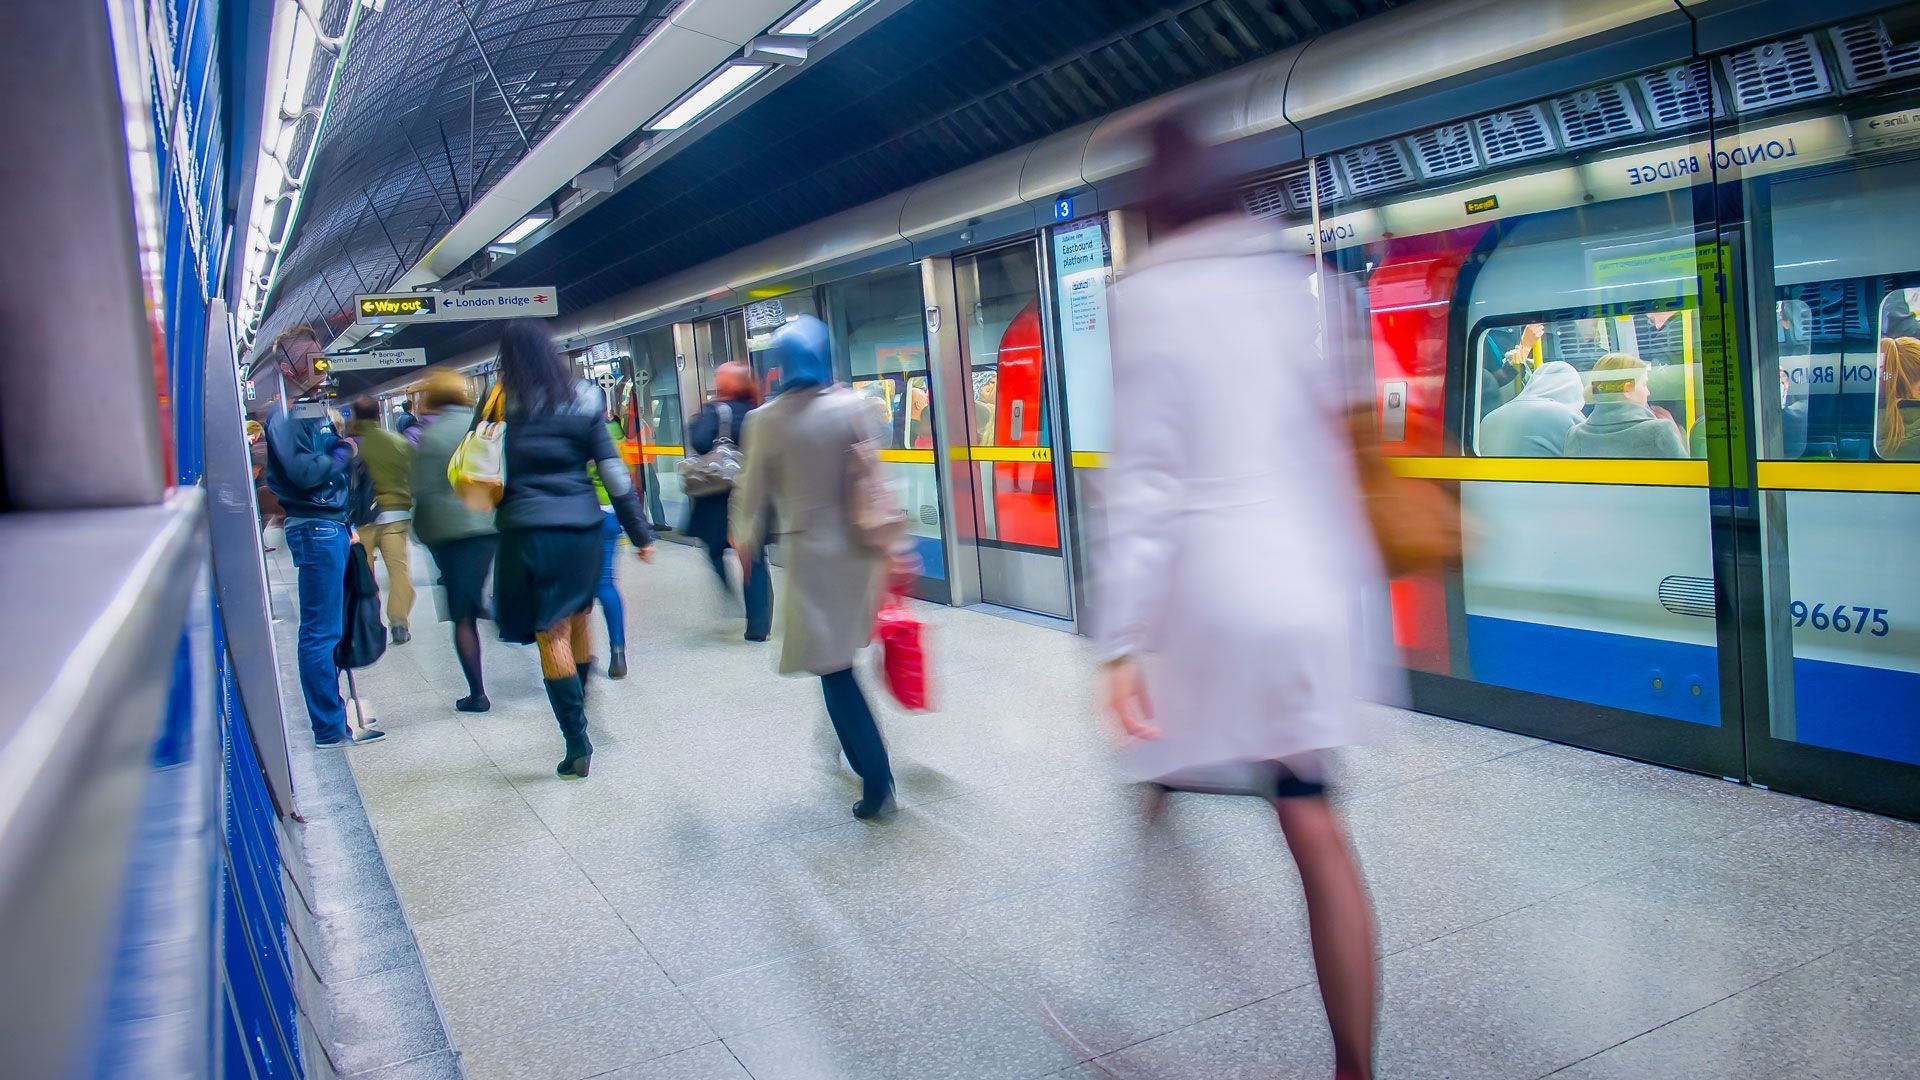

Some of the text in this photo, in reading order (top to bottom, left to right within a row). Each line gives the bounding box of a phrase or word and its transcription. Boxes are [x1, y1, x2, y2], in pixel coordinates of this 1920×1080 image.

[1060, 201, 1069, 217] 3
[1062, 239, 1093, 255] Eastbound
[1063, 255, 1088, 269] platform
[375, 299, 422, 313] Way out
[455, 296, 530, 307] London Bridge
[378, 351, 405, 359] Borough
[1790, 600, 1889, 637] 96675
